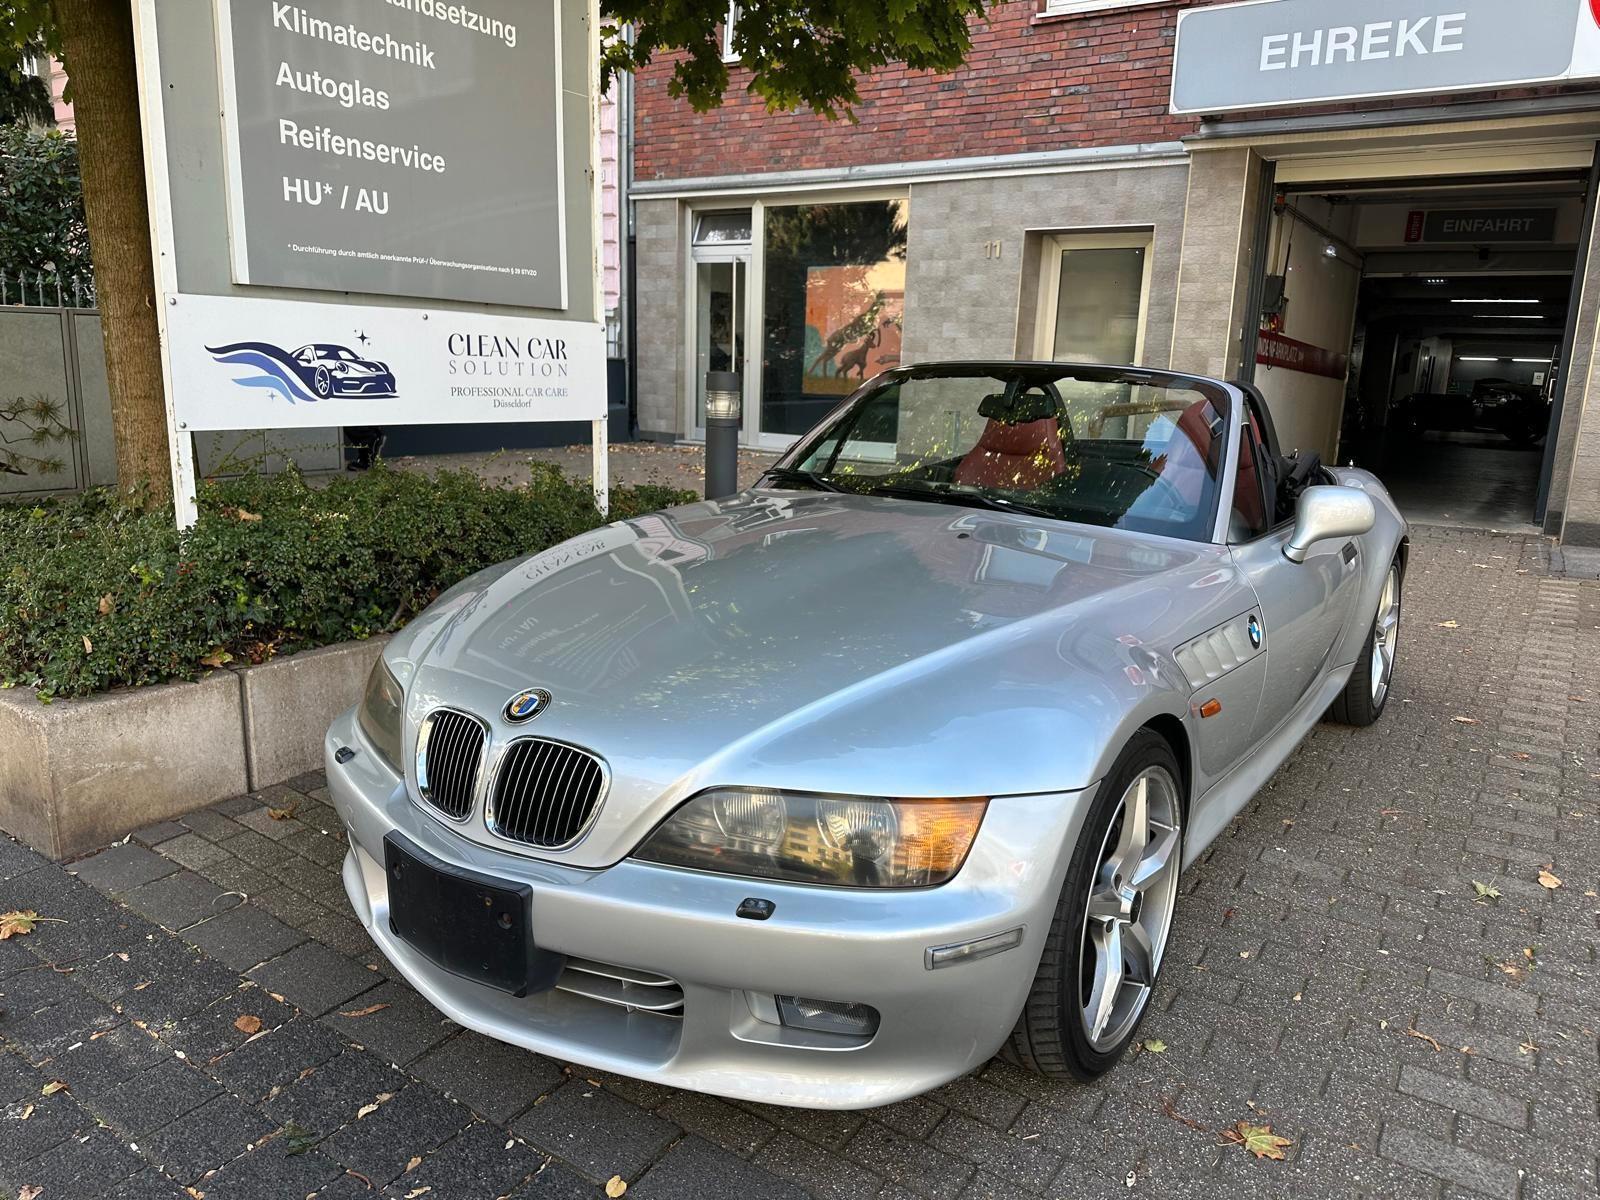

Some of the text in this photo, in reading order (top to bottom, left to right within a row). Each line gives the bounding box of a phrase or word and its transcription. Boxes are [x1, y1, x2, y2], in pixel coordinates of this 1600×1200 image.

[272, 1, 435, 69] Klimatechnik
[1259, 12, 1467, 71] EHREKE
[276, 62, 390, 109] Autoglas
[279, 119, 446, 173] Reifenservice
[340, 185, 349, 208] /
[355, 189, 389, 215] AU
[1443, 218, 1534, 233] EINFAHRT
[292, 244, 337, 257] Durchführung
[338, 249, 356, 257] durch
[357, 251, 379, 260] amtlich
[380, 254, 412, 263] anerkannte
[429, 257, 497, 271] Überwachungsorganisation
[498, 266, 510, 274] nach
[984, 240, 1001, 259] 11
[448, 333, 567, 360] CLEAN CAR
[449, 360, 567, 376] SOLUTION
[451, 387, 568, 397] PROFESSIONAL CAR CARE
[493, 399, 532, 408] Düsseldorf
